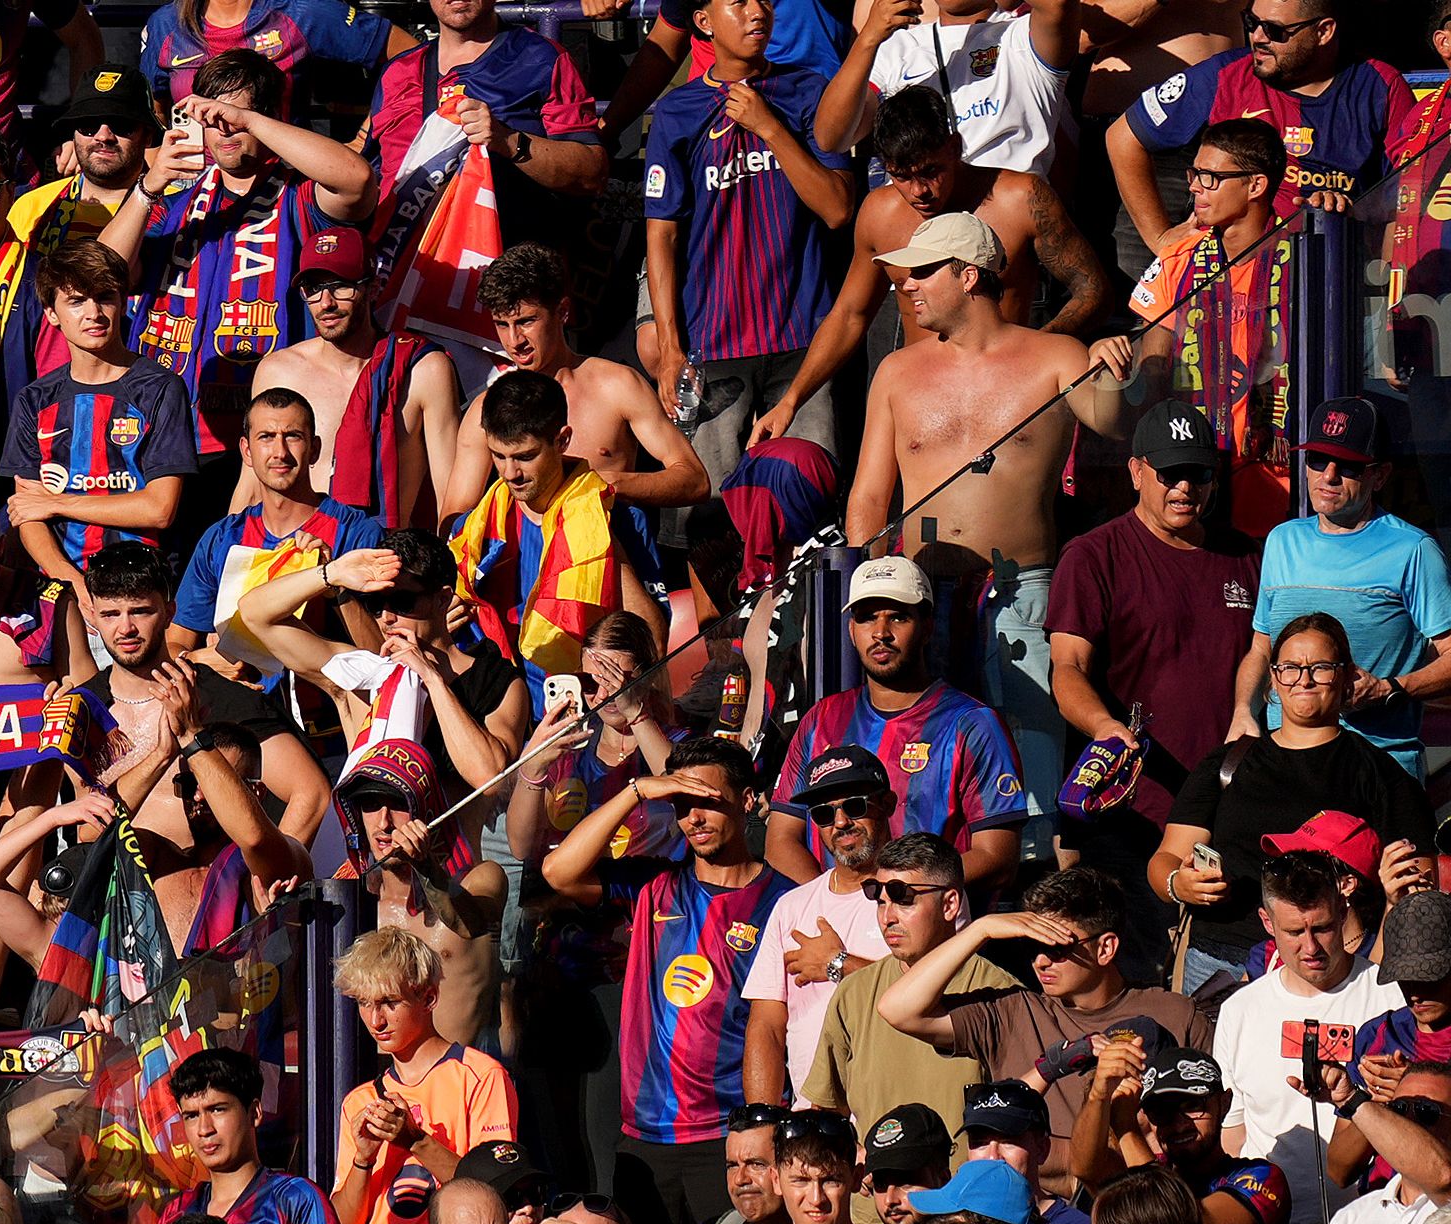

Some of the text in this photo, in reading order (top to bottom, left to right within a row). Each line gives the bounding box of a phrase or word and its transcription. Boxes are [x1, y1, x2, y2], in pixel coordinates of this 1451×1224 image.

[1285, 164, 1355, 191] Spotify
[1168, 416, 1194, 442] NY
[70, 471, 138, 493] Spotify
